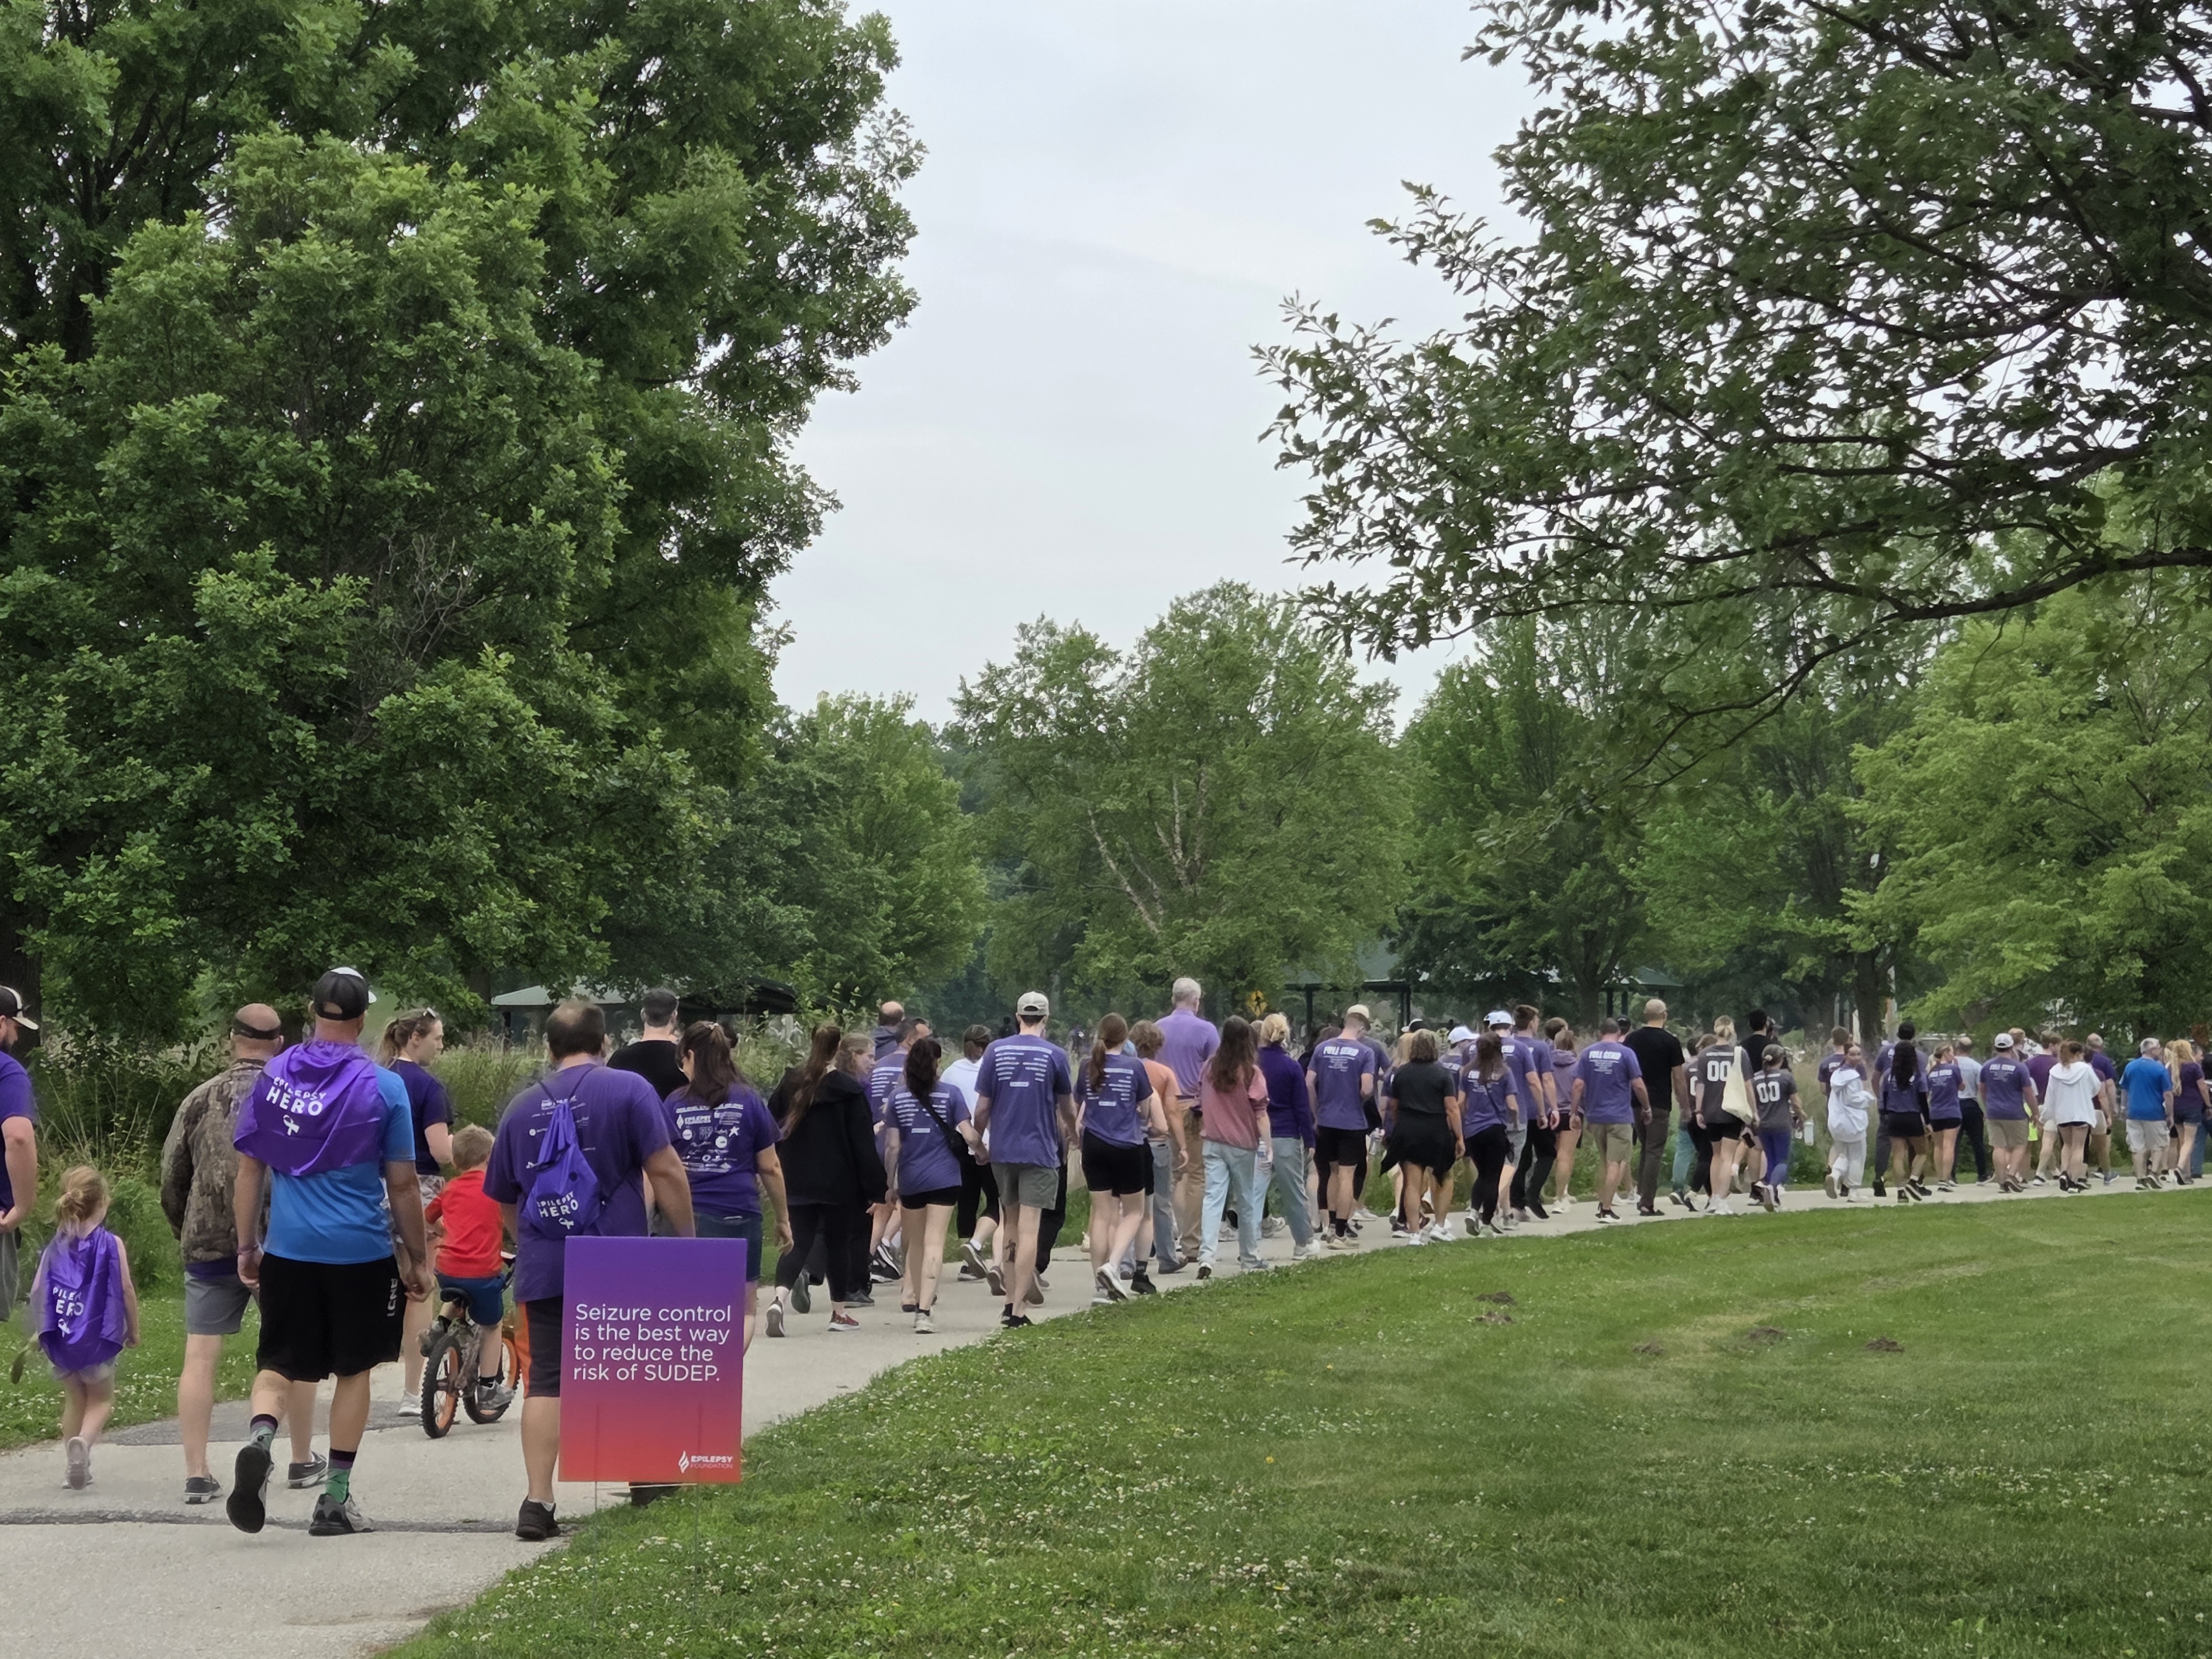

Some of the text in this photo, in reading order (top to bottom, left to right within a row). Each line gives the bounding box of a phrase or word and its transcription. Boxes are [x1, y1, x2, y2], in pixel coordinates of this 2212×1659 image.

[273, 1077, 327, 1100] EPILEPSY
[1756, 1081, 1780, 1103] 00
[265, 1086, 323, 1116] HERO
[539, 1199, 578, 1218] HERO
[576, 1303, 731, 1322] Seizure control
[575, 1323, 730, 1345] is the best way
[574, 1343, 713, 1361] to reduce the
[573, 1363, 719, 1381] risk of SUDEP.
